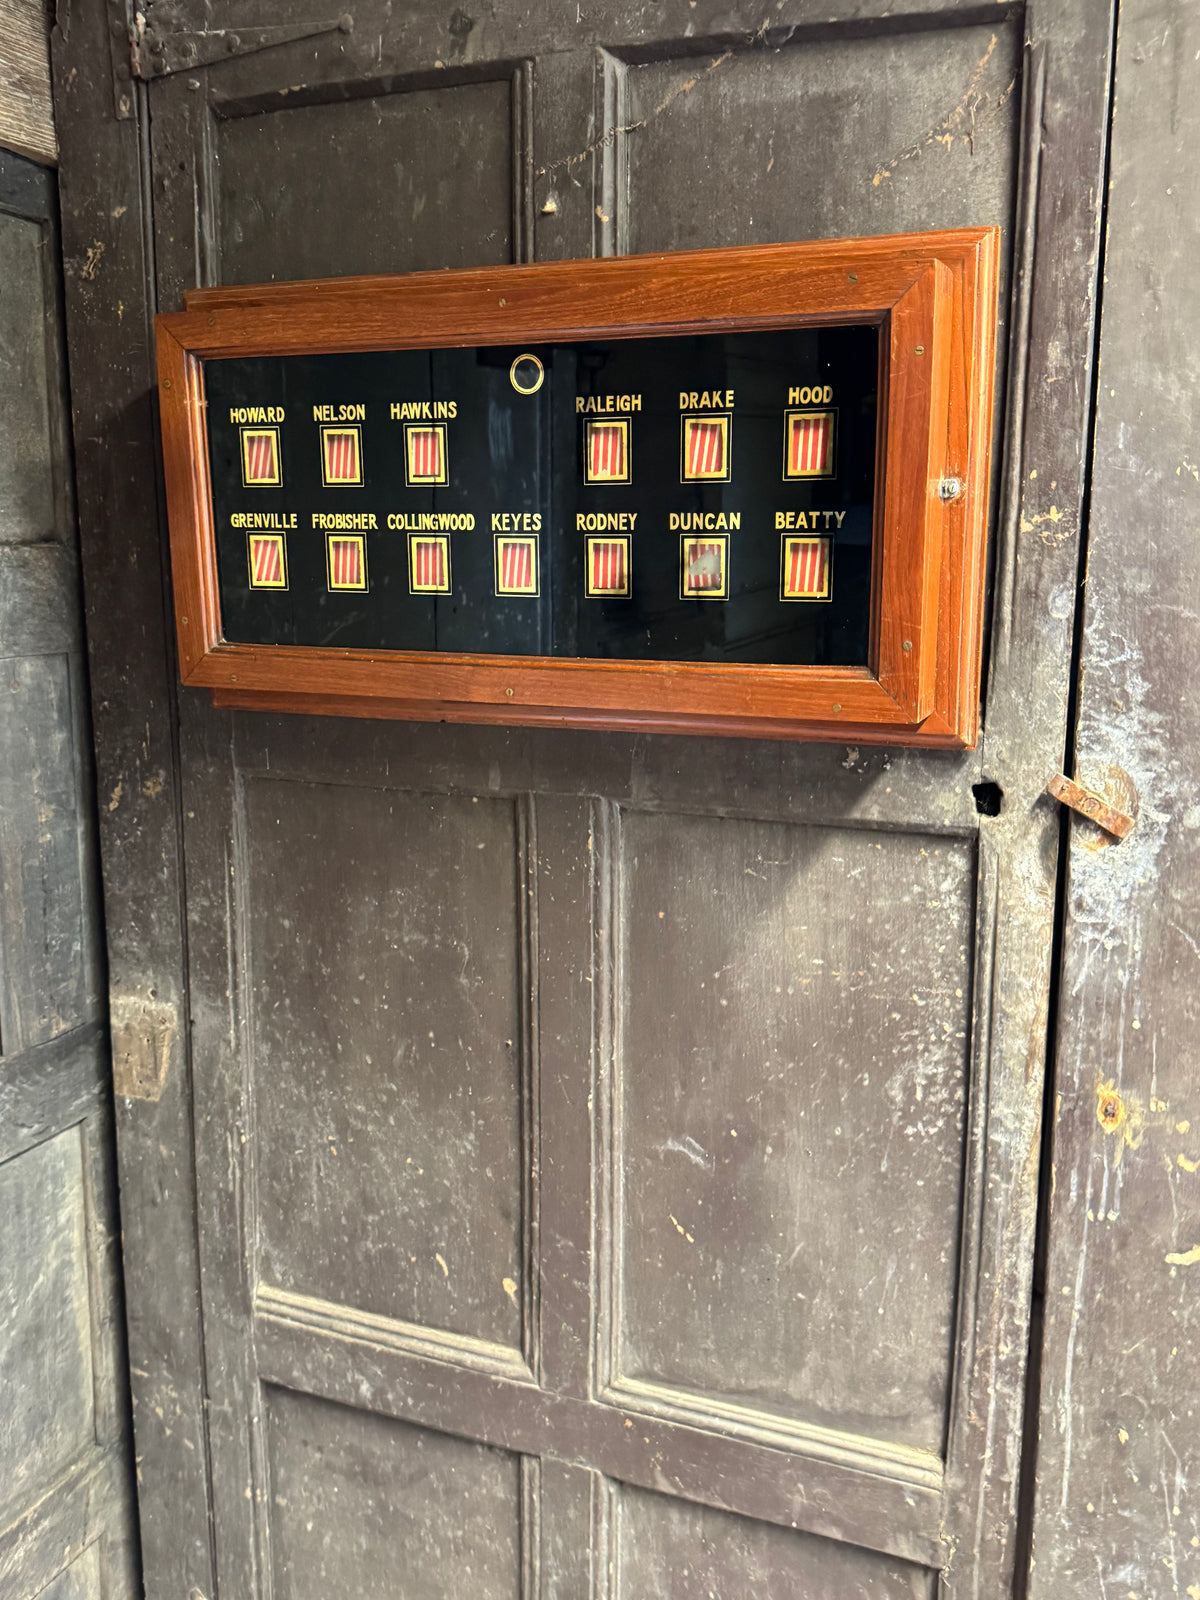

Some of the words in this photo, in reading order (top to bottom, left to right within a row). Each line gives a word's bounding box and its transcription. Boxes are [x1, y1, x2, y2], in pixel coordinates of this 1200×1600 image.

[576, 395, 641, 412] RALEIGH
[680, 390, 734, 409] DRAKE
[789, 386, 832, 404] HOOD
[230, 407, 285, 423] HOWARD
[313, 404, 365, 421] NELSON
[391, 401, 457, 419] HAWKINS
[231, 513, 297, 528] GRENVILLE
[312, 514, 378, 529] FROBISHER
[387, 514, 475, 530] COLLINGWOOD
[492, 513, 542, 531] KEYES
[577, 513, 637, 530] RODNEY
[670, 512, 740, 530] DUNCAN
[775, 511, 845, 529] BEATTY
